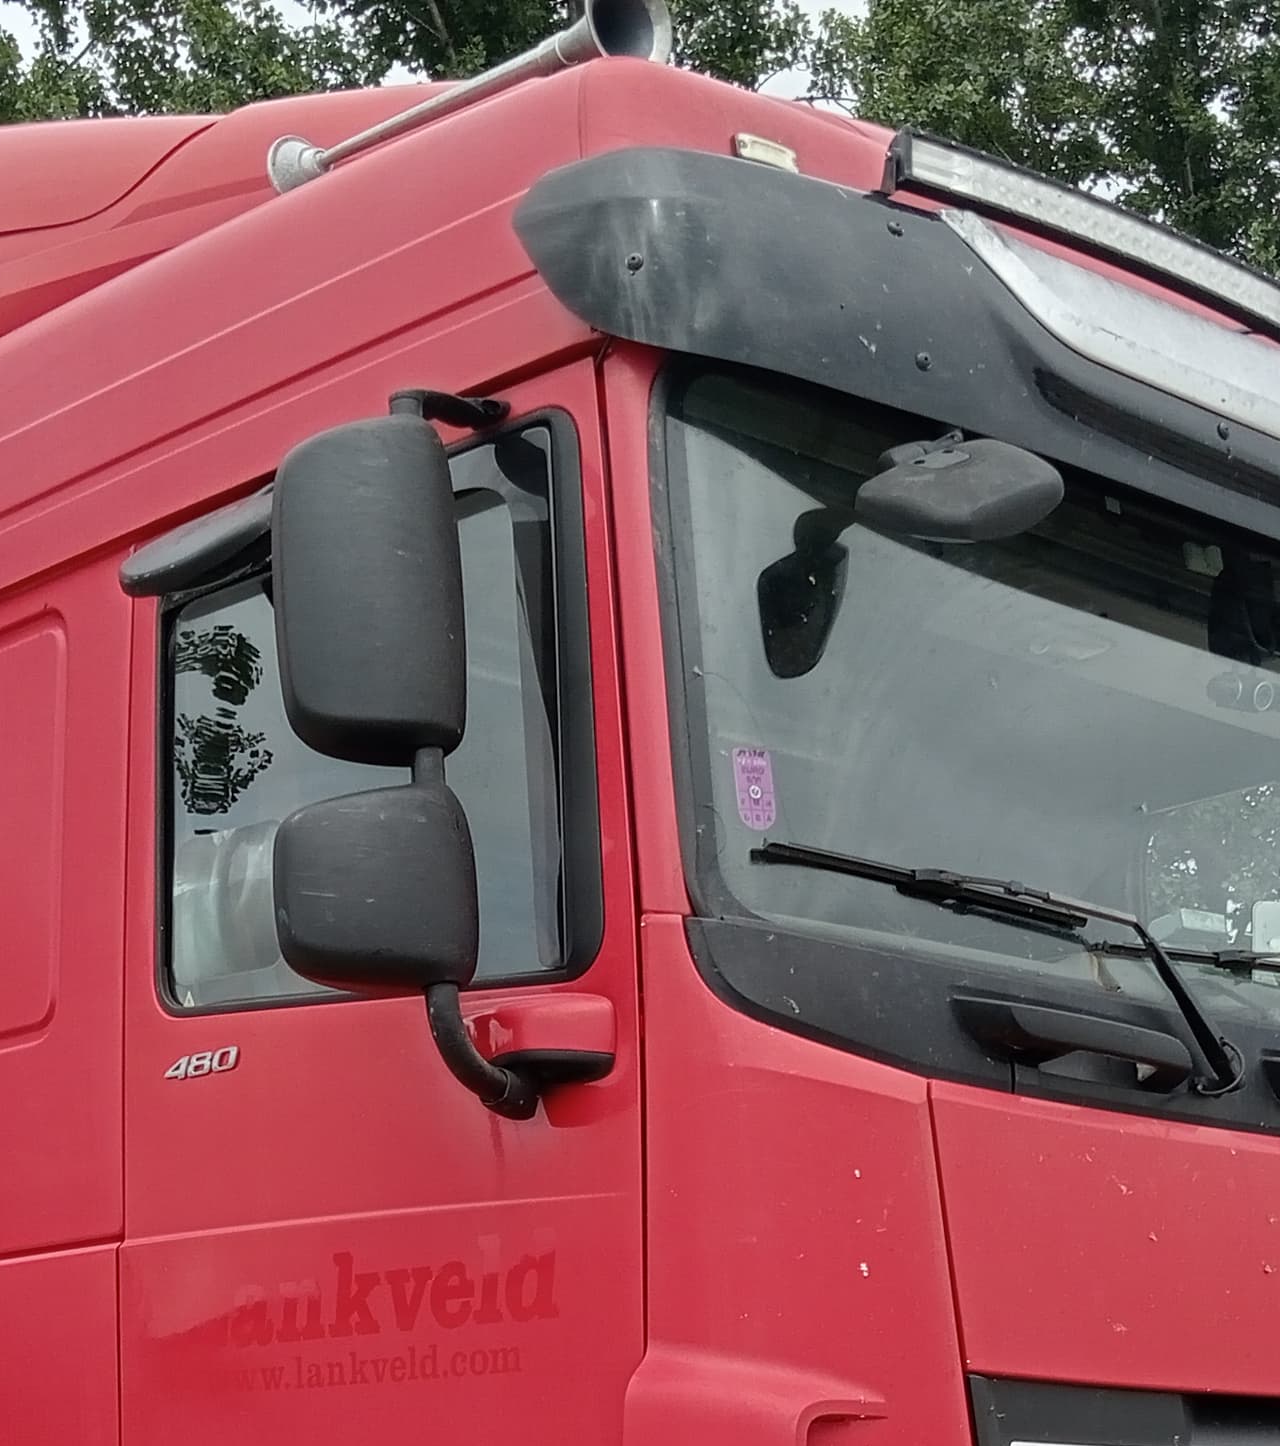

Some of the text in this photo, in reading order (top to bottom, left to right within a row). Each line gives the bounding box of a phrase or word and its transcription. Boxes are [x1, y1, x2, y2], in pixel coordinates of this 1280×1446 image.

[163, 1046, 239, 1081] 480
[223, 1230, 561, 1348] ankveld
[233, 1344, 524, 1392] ww.lankveld.com
